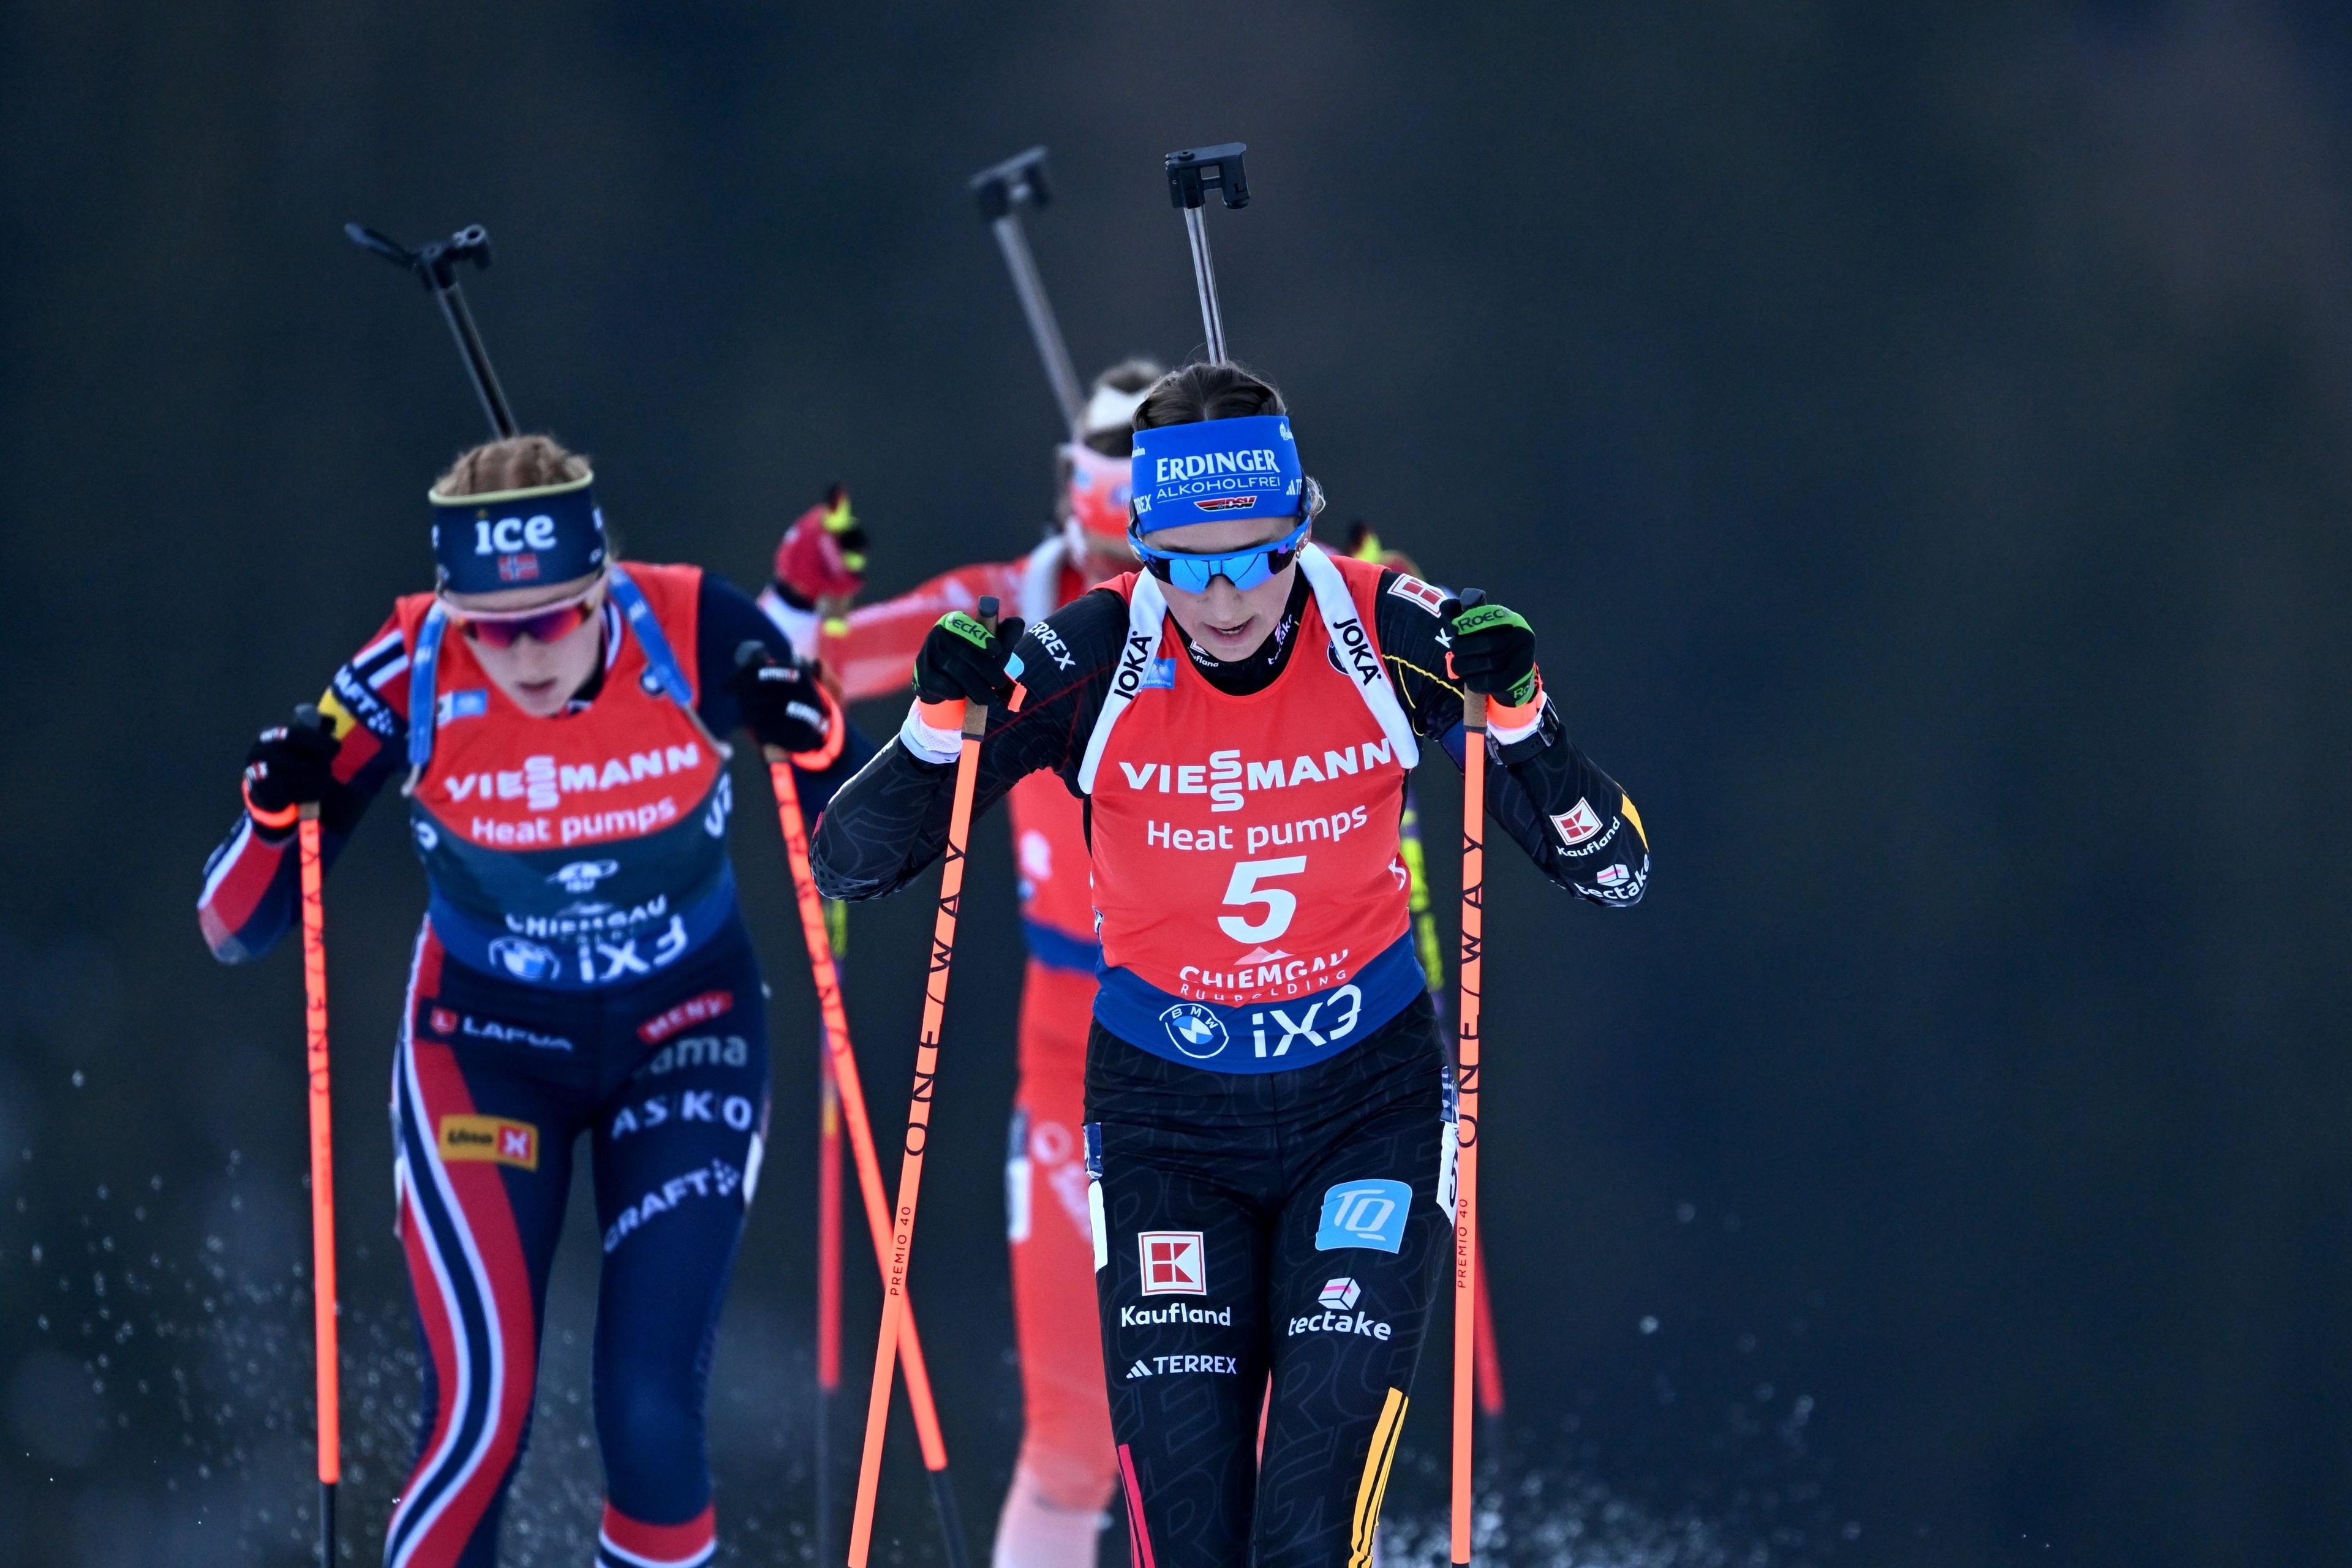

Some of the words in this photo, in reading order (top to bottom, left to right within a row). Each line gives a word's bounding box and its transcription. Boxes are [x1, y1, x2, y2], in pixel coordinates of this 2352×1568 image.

[1156, 449, 1281, 483] ERDINGER
[1156, 476, 1281, 499] ALKOHOLFREI
[1028, 620, 1076, 671] ERREX
[1332, 617, 1379, 687] JOKA
[444, 741, 701, 812] VIESSMANN
[1119, 737, 1393, 813] VIESSMANN
[472, 816, 551, 845] Heat
[561, 797, 676, 846] pumps
[1147, 820, 1234, 851] Heat
[1247, 805, 1368, 854] pumps
[1555, 815, 1621, 857] Kaufland
[1217, 855, 1307, 944] 5
[1574, 853, 1649, 899] tectake
[1180, 949, 1348, 989] CHIEMGAU
[1252, 984, 1362, 1058] iX3
[648, 1034, 747, 1076] ama
[611, 1089, 753, 1140] ASKO
[1459, 1199, 1468, 1218] 40
[890, 1234, 907, 1295] PREMIO
[900, 1207, 911, 1226] 40
[1457, 1227, 1467, 1288] PREMIO
[1121, 1302, 1231, 1328] Kaufland
[1288, 1311, 1392, 1341] tectake
[1153, 1355, 1237, 1375] TERREX
